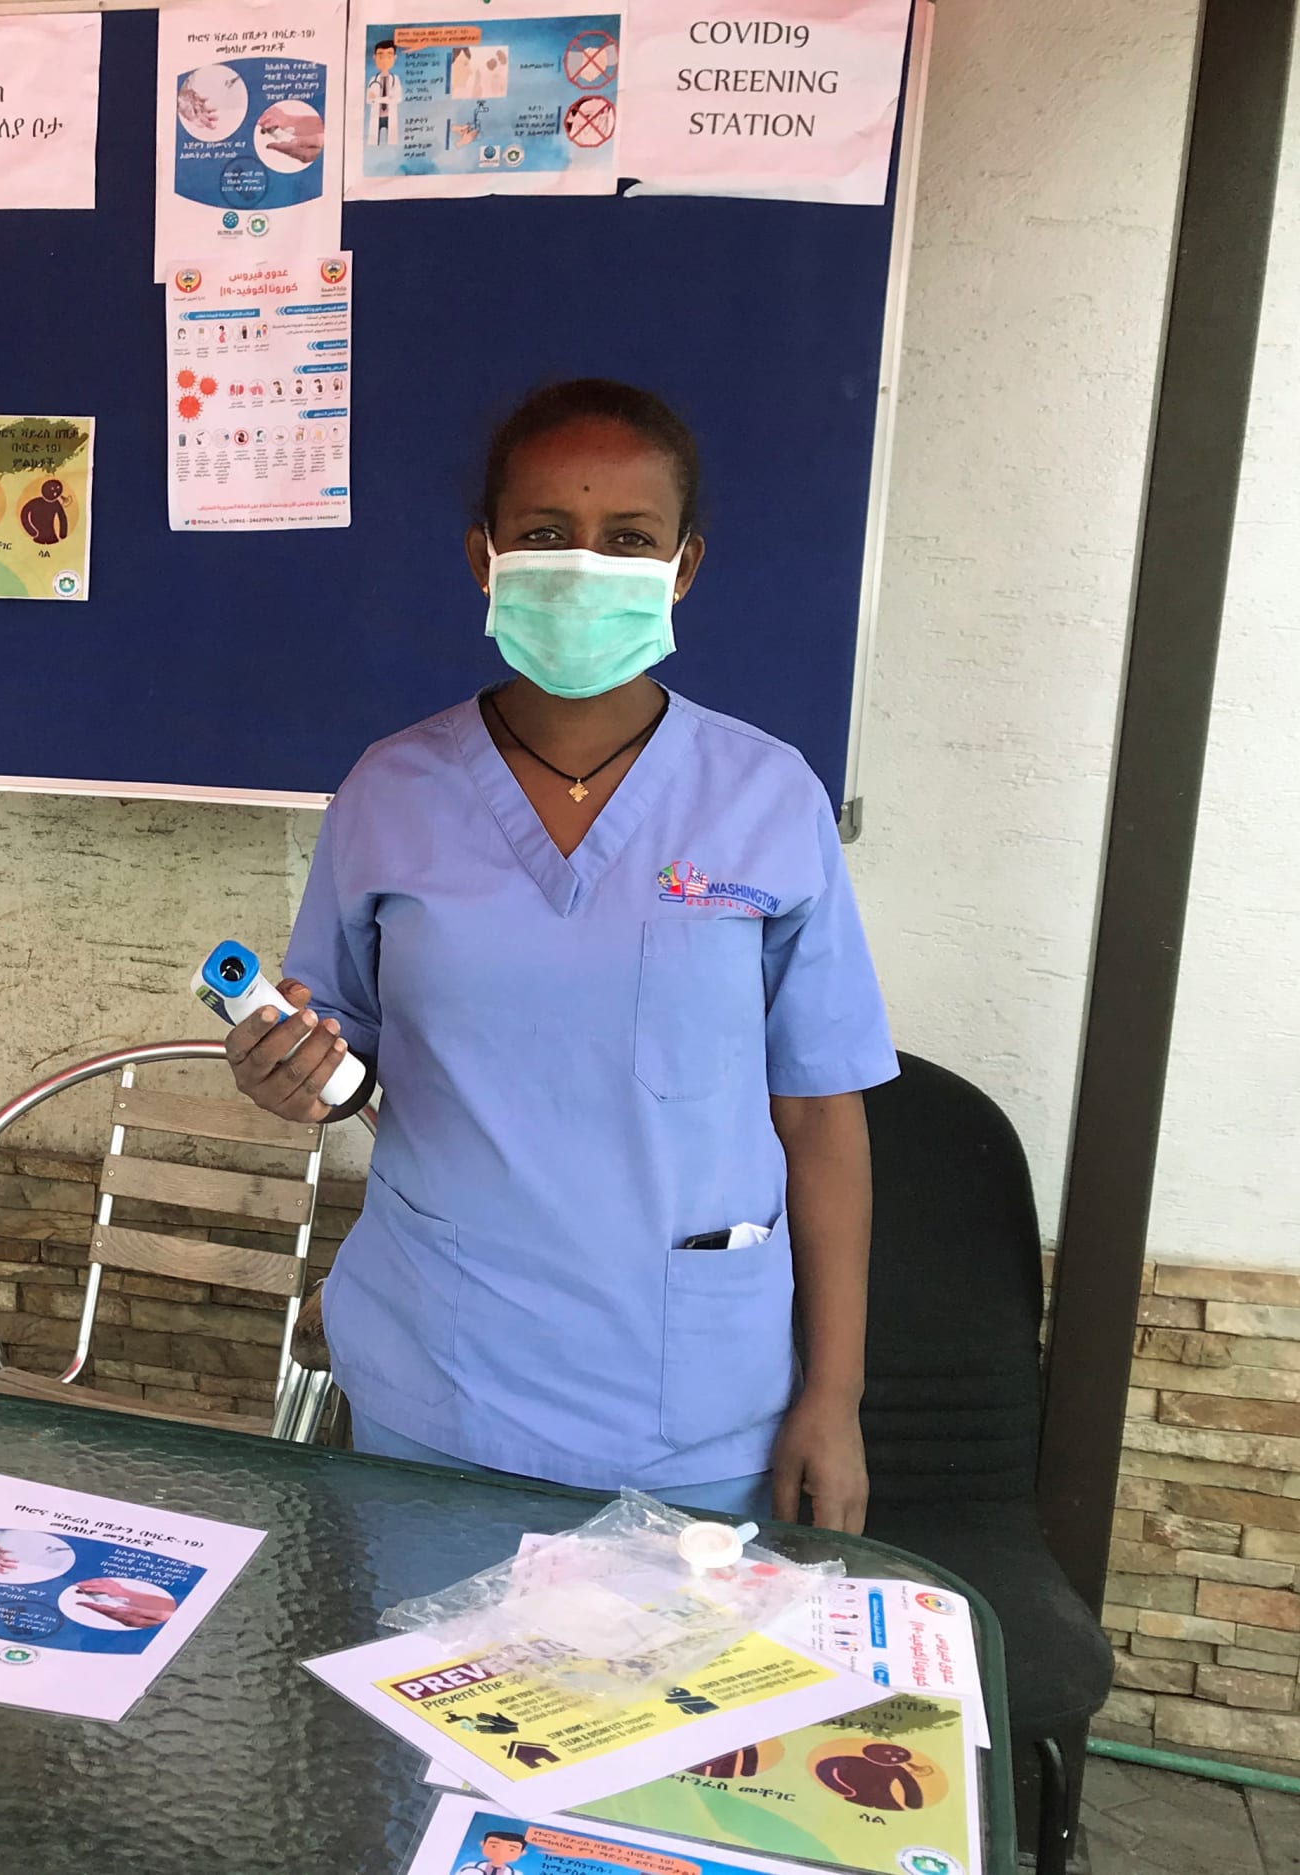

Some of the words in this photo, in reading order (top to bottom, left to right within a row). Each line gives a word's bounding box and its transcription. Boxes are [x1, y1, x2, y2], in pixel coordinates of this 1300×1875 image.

[689, 21, 810, 48] COVID19
[676, 68, 839, 94] SCREENING
[32, 116, 63, 139] ቦታ
[689, 112, 816, 137] STATION
[228, 269, 263, 281] فيروس
[264, 269, 289, 280] عدوى
[268, 282, 298, 295] كورونا
[686, 897, 741, 911] MEDICAL
[707, 882, 782, 912] WASHINGTON
[420, 1688, 478, 1710] Prevent
[478, 1679, 504, 1694] the
[516, 1689, 535, 1701] YOUR
[546, 1730, 564, 1740] STAY
[563, 1723, 586, 1737] HOME
[558, 1735, 583, 1748] CLEAN
[589, 1722, 624, 1740] DISINFECT
